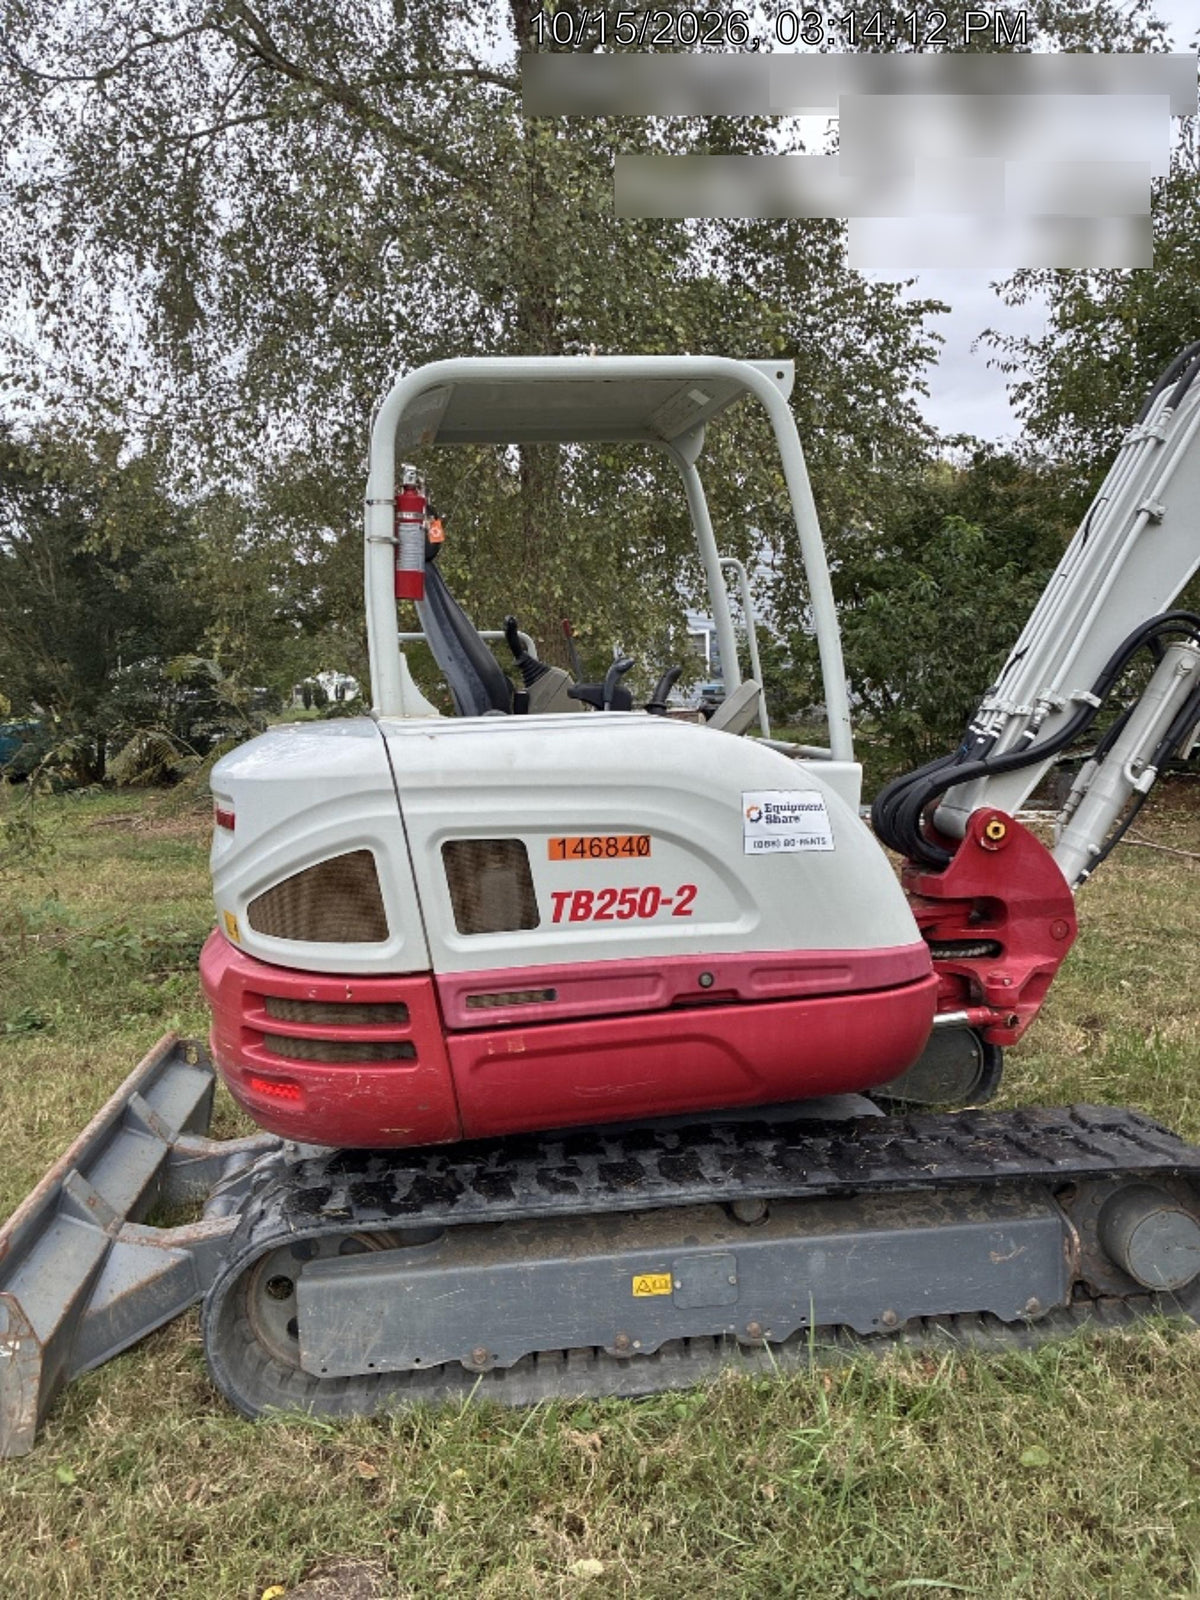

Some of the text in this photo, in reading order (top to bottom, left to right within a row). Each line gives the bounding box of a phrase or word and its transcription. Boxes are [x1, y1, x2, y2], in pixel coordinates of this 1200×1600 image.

[764, 802, 824, 814] Equipment
[765, 814, 801, 824] Share
[557, 835, 650, 859] 146840
[551, 885, 698, 923] TB250-2
